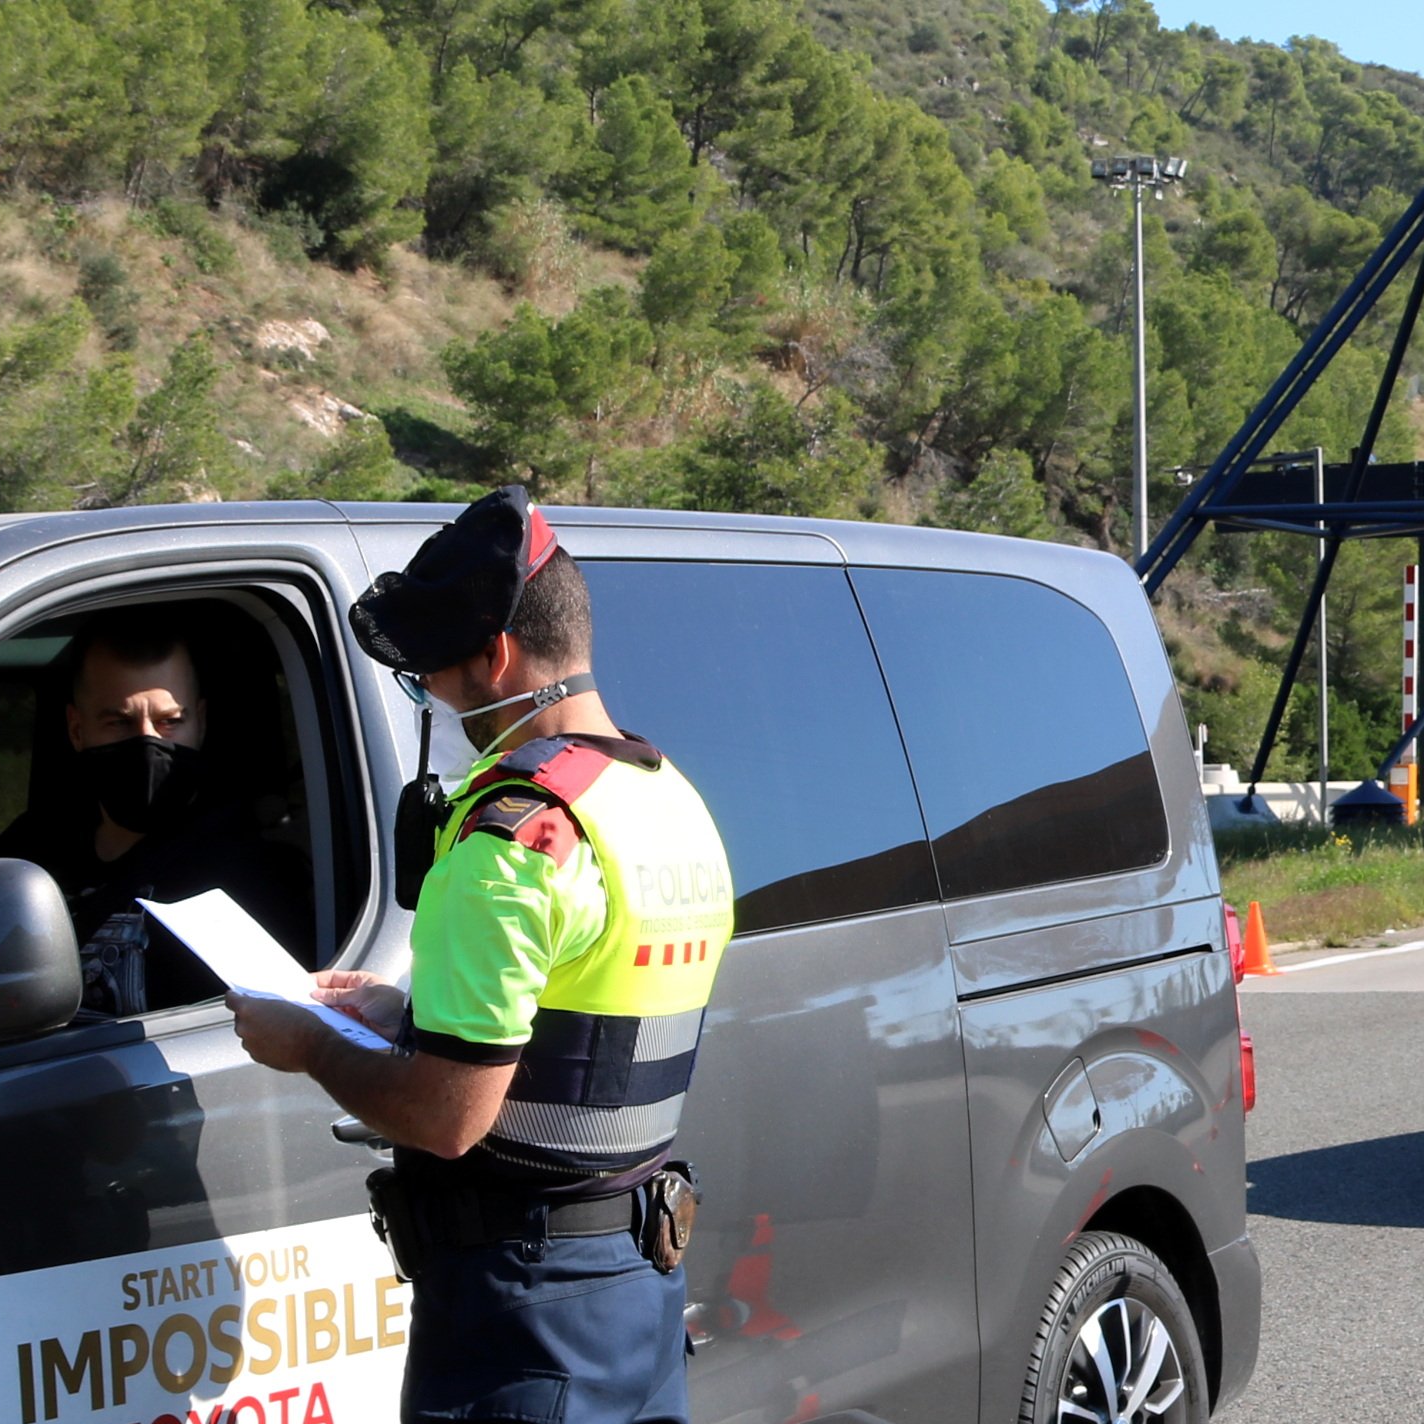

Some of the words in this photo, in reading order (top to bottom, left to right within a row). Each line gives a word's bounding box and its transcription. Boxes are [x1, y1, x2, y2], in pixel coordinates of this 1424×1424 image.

[636, 862, 728, 907] POLICIA
[121, 1259, 218, 1311] START
[224, 1245, 309, 1291] YOUR
